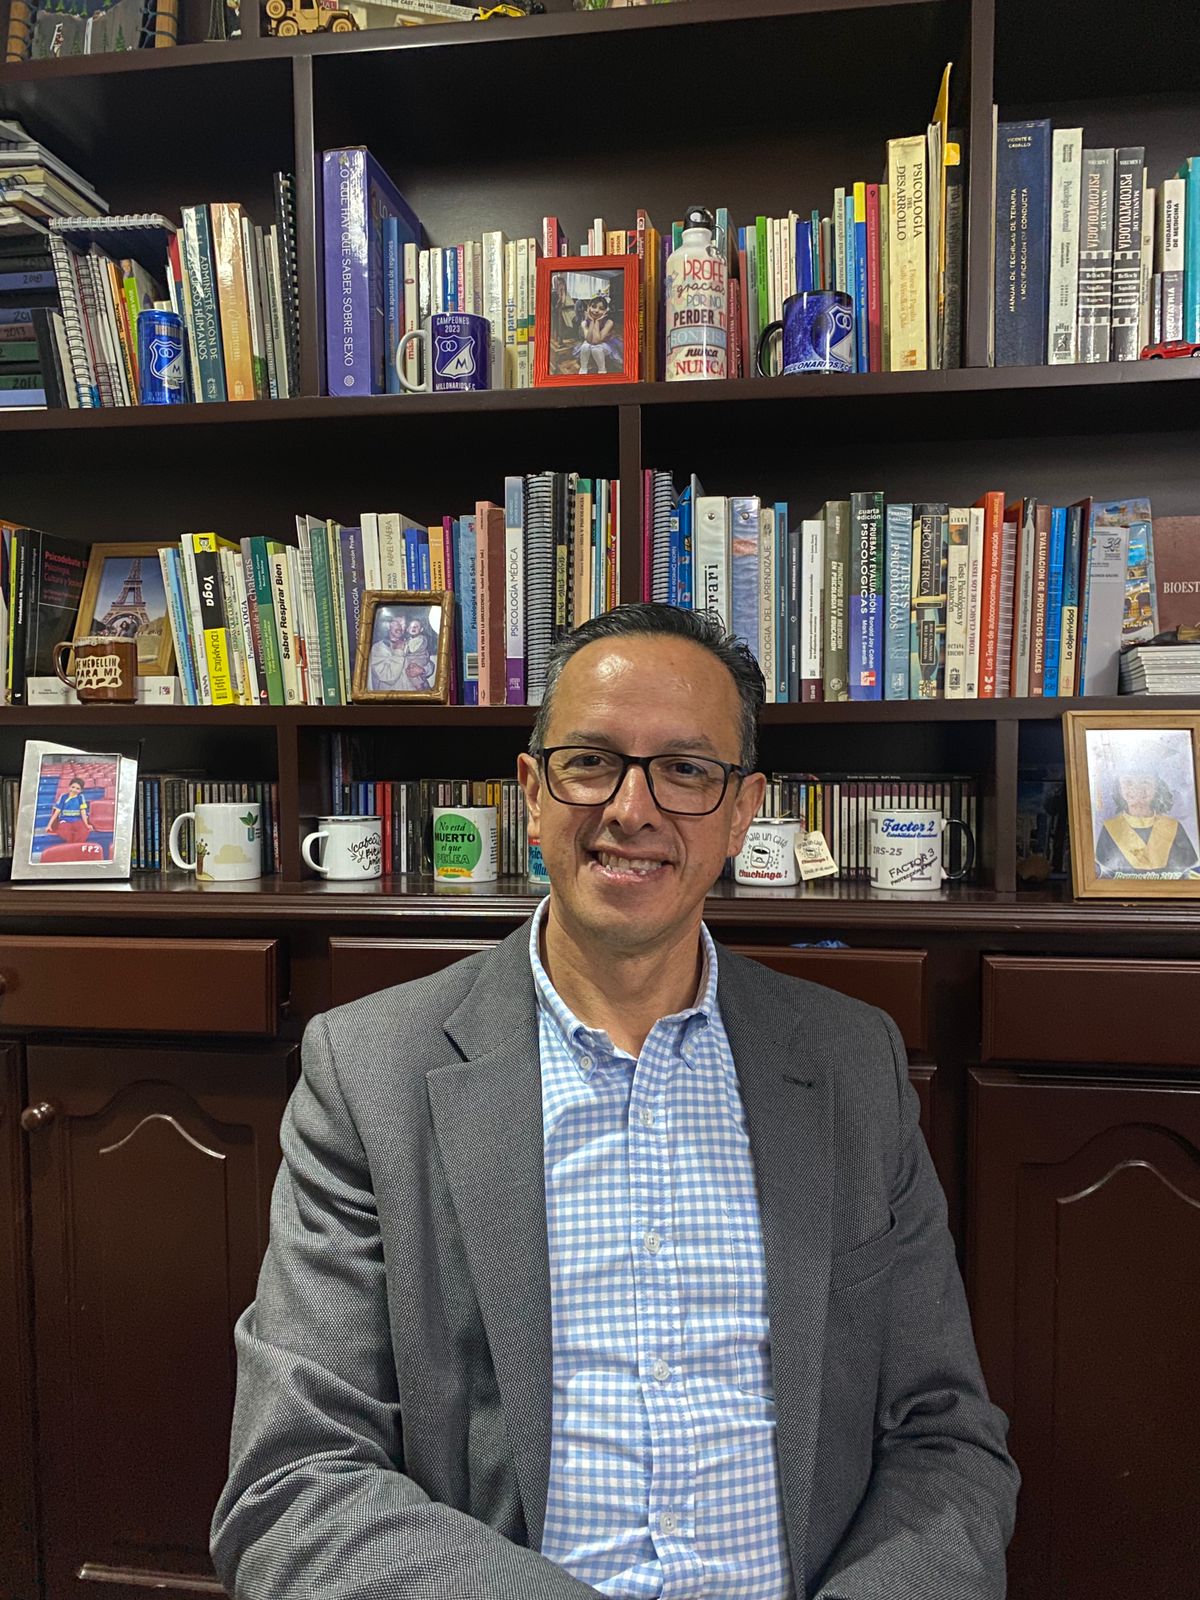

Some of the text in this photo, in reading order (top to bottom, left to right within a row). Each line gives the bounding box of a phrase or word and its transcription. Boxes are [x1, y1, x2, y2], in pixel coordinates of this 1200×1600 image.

[896, 165, 907, 241] DESARROLLO
[911, 162, 925, 239] PSICOLOGÍA
[1020, 187, 1028, 229] CONDUCTA
[1061, 180, 1072, 233] Psicología Anormal
[1087, 173, 1101, 249] PSICOPATOLOGÍA
[1100, 189, 1108, 231] MANUAL DE
[1118, 173, 1133, 250] PSICOPATOLOGÍA
[1132, 189, 1140, 232] MANUAL DE
[837, 212, 844, 220] de
[1010, 221, 1017, 231] DE
[1172, 238, 1179, 248] DE
[340, 181, 354, 366] QUE HAY QUE SABER SOBRE SEXO
[388, 269, 394, 278] de
[683, 259, 724, 283] PROFE
[1009, 270, 1016, 281] DE
[686, 294, 722, 307] POR NO
[1008, 283, 1016, 312] MANUAL
[436, 316, 470, 325] CAMPEONES
[444, 325, 461, 334] 2023
[506, 297, 516, 345] la pareja
[673, 309, 715, 327] PERDER
[194, 308, 208, 361] HUMANOS
[209, 348, 218, 360] DE
[684, 347, 718, 358] nunca
[675, 359, 725, 376] NUNCA
[857, 513, 881, 521] edición
[869, 523, 877, 556] PRUEBAS
[988, 531, 1000, 567] superación
[830, 560, 837, 570] EN
[920, 517, 933, 596] PSICOMÉTRICA
[971, 559, 979, 577] TESTS
[244, 558, 258, 602] chakras
[836, 562, 844, 598] PRINCIPIOS
[957, 562, 966, 579] Tests
[201, 575, 216, 607] Yoga
[468, 557, 477, 630] Psicología de la Salud
[508, 547, 519, 637] PSICOLOGÍA MÉDICA
[762, 545, 772, 622] DEL APRENDIZAJE
[868, 564, 878, 614] EVALUACIÓN
[900, 565, 911, 609] TESTS
[947, 575, 958, 612] Evaluación
[1022, 571, 1031, 598] epidemiológica
[836, 598, 843, 607] DE
[954, 579, 966, 620] Psicológicos
[969, 593, 977, 603] DE
[987, 573, 997, 630] autoconocimiento
[1036, 531, 1048, 673] EVALUACION DE PROYECTOS SOCIALES
[253, 613, 260, 622] de
[275, 563, 291, 660] Saber Respirar Bien
[836, 607, 843, 616] LA
[967, 604, 977, 631] CLÁSICA
[1021, 598, 1029, 623] investigación
[241, 600, 253, 660] Practicando YOGA
[254, 623, 262, 639] vital
[830, 615, 838, 652] EDUCACION
[965, 608, 975, 660] La objetividad
[986, 630, 995, 639] de
[210, 634, 224, 673] DUMMIES
[257, 640, 266, 665] energía
[867, 636, 875, 648] Jay
[966, 632, 976, 655] TEORÍA
[985, 640, 994, 657] Tests
[77, 668, 117, 679] PARA MI
[83, 658, 117, 669] MEDELLIN
[260, 666, 266, 674] La
[985, 658, 993, 670] Los
[77, 677, 120, 687] PAPA
[439, 821, 466, 832] No está
[762, 831, 772, 841] un
[881, 818, 935, 833] Factor 2
[81, 845, 101, 853] FP2
[434, 833, 476, 843] MUERTO
[441, 844, 462, 854] el que
[437, 854, 470, 865] PELEA
[873, 845, 904, 857] IRS-25
[888, 847, 936, 878] FACTOR 3
